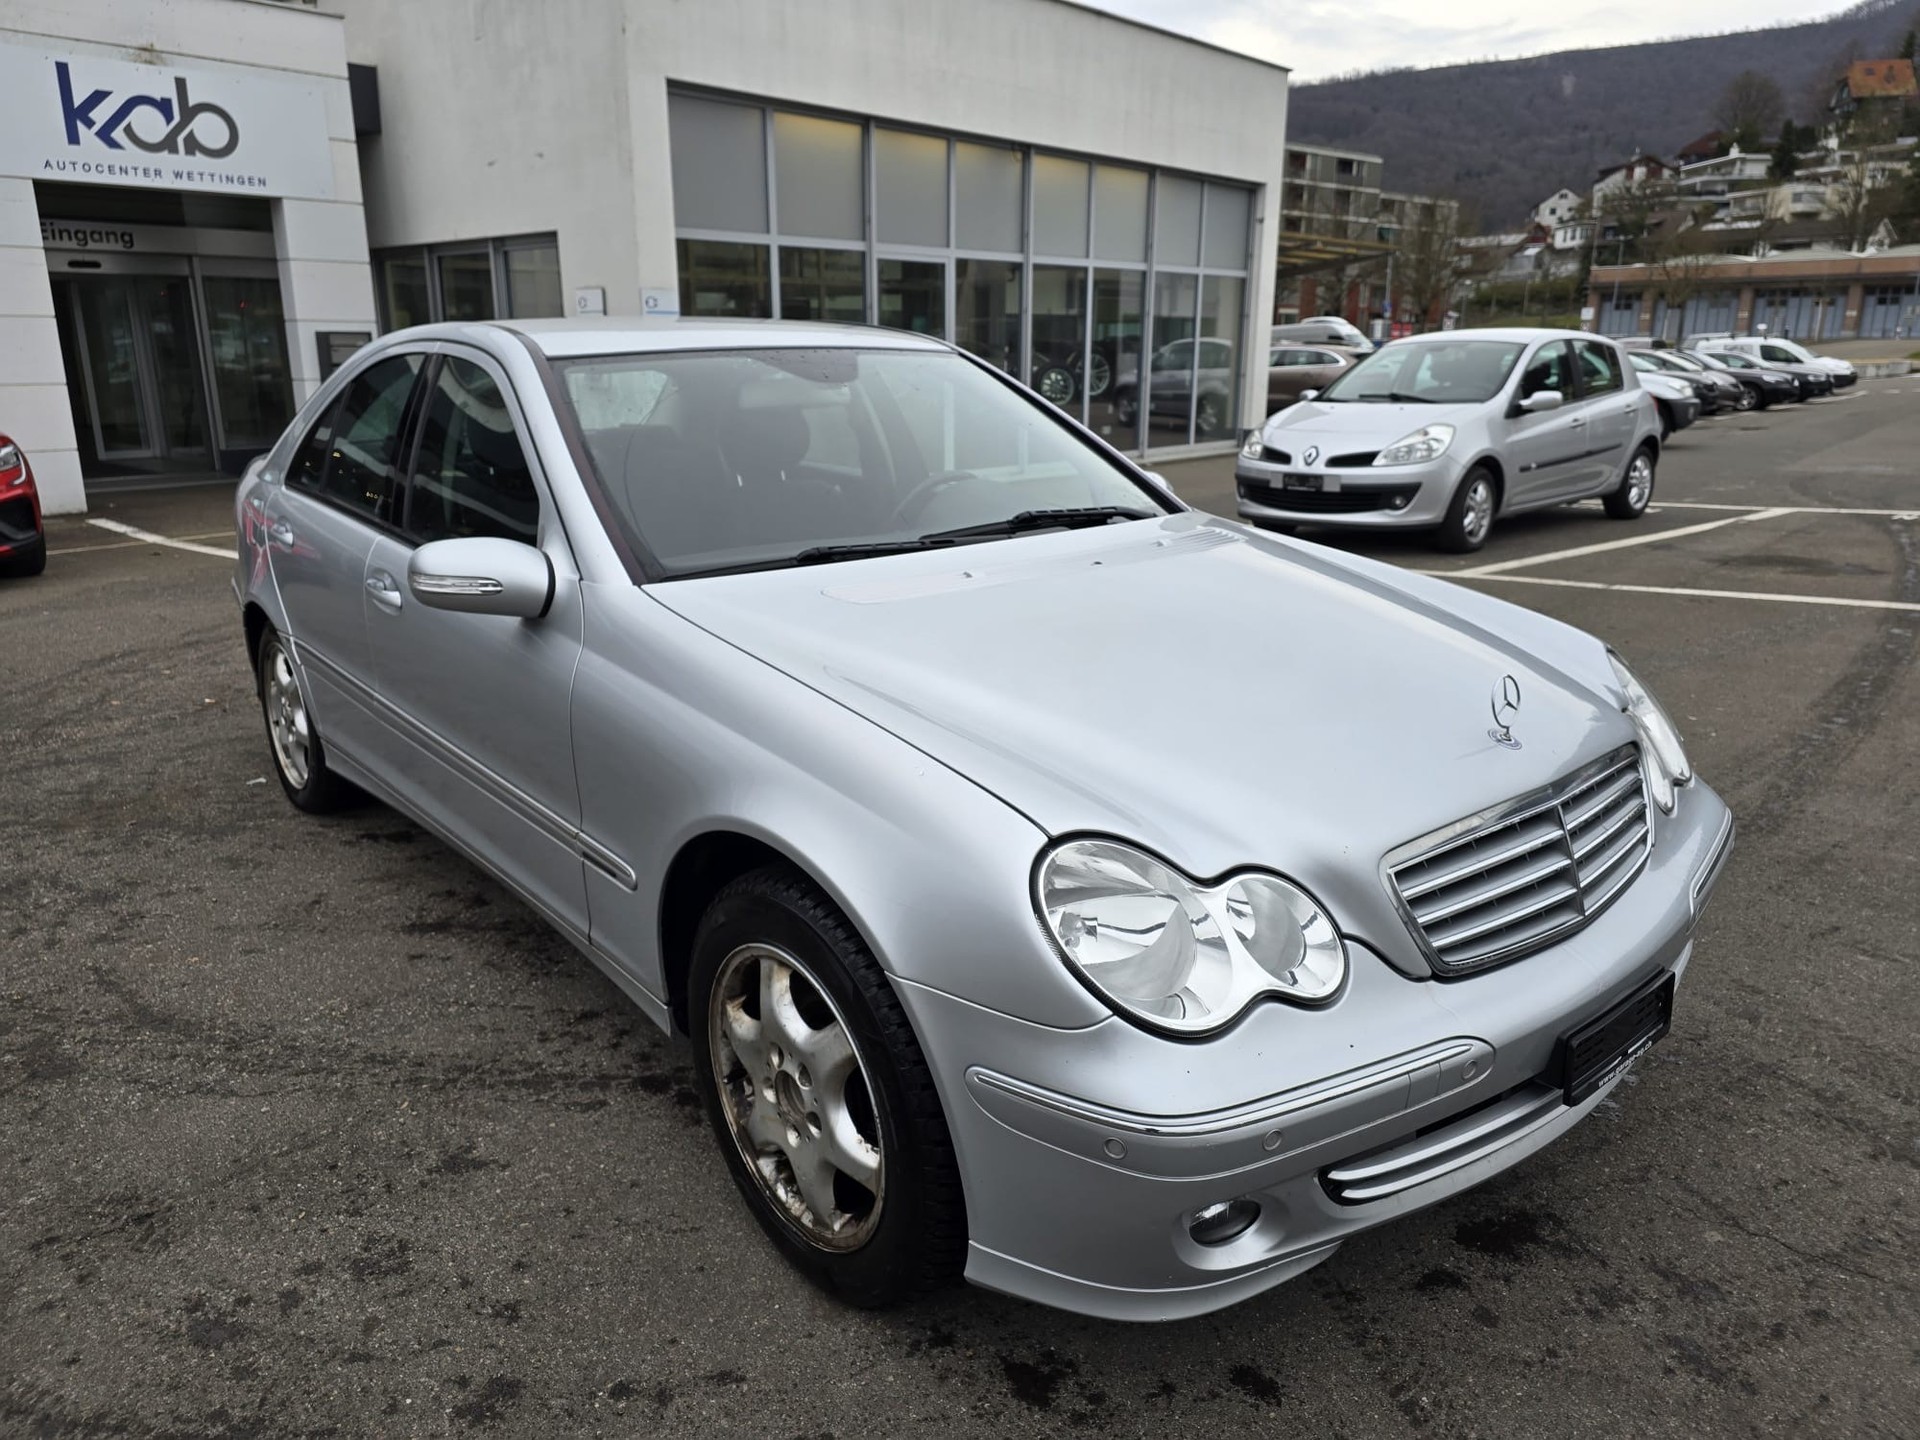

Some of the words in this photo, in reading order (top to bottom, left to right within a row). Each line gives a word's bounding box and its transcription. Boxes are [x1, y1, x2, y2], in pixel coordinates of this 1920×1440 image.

[55, 61, 239, 159] kab
[43, 159, 163, 179] AUTOCENTER
[172, 169, 267, 187] WETTINGEN
